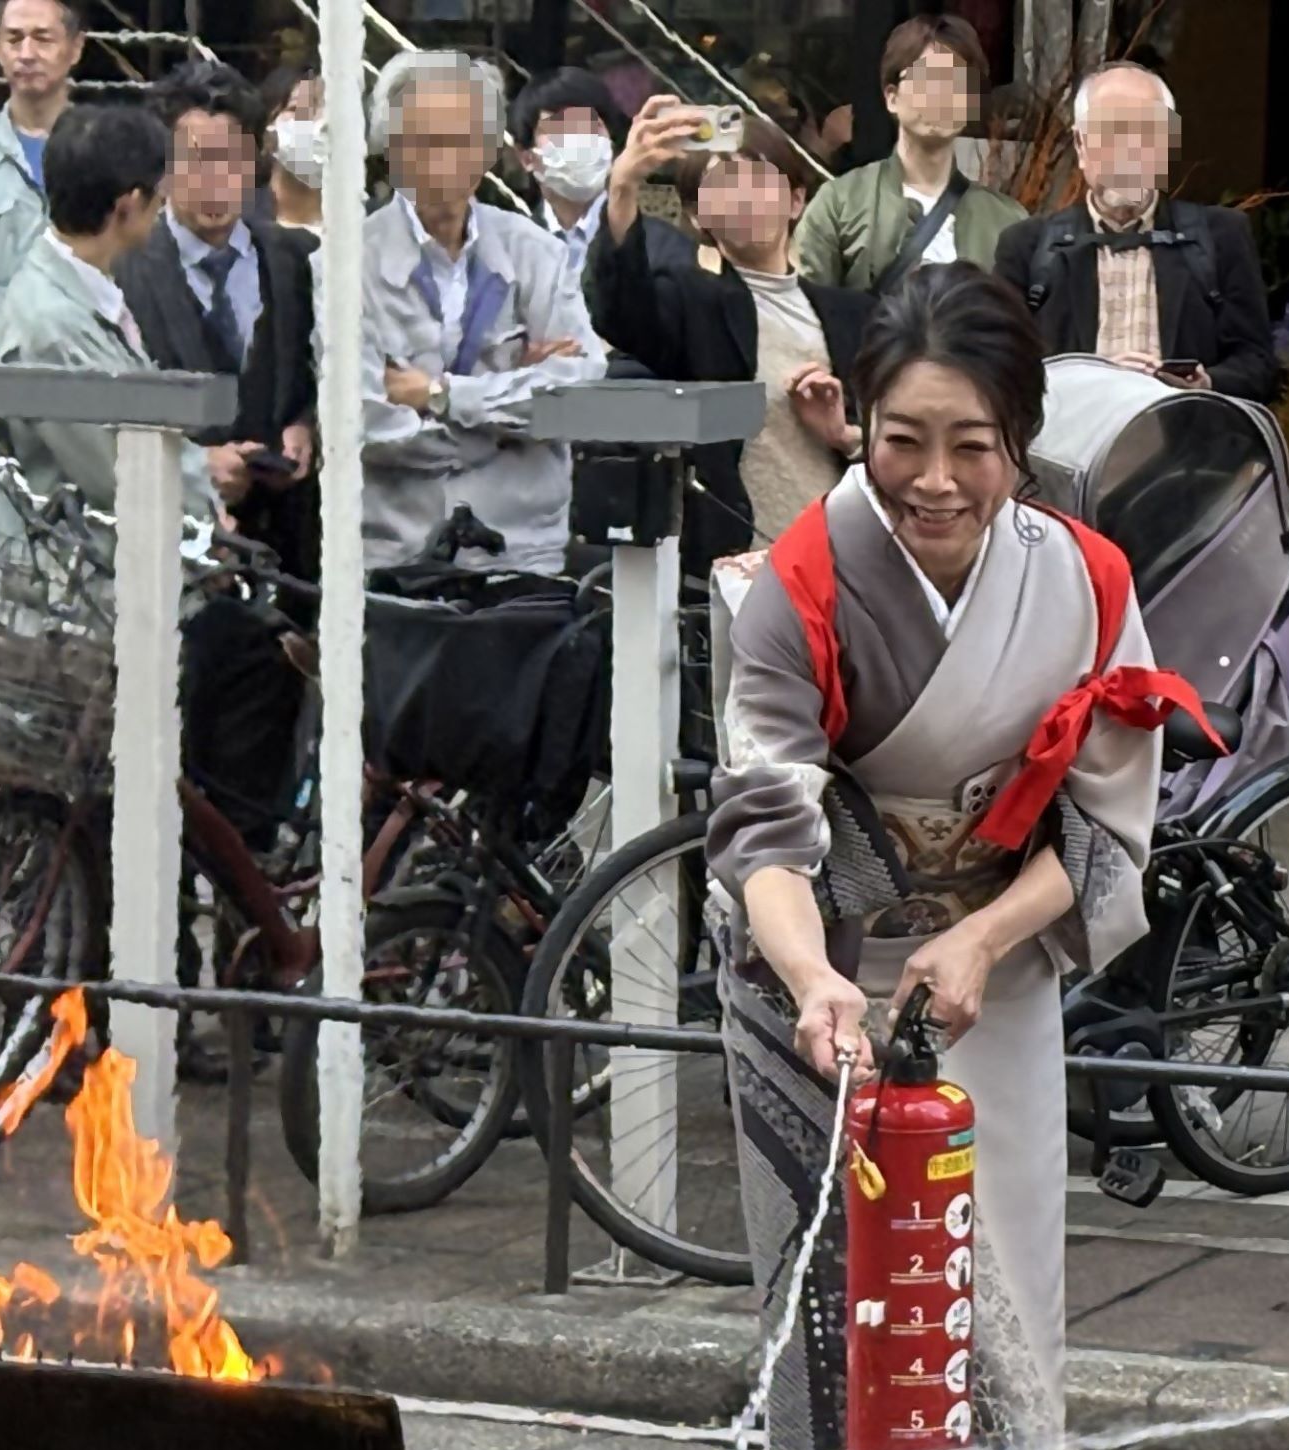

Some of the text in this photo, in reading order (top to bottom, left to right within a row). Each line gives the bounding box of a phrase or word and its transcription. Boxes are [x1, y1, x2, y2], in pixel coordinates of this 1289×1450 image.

[911, 1200, 921, 1220] 1
[909, 1253, 924, 1273] 2
[910, 1305, 923, 1325] 3
[909, 1357, 925, 1375] 4
[910, 1409, 925, 1429] 5
